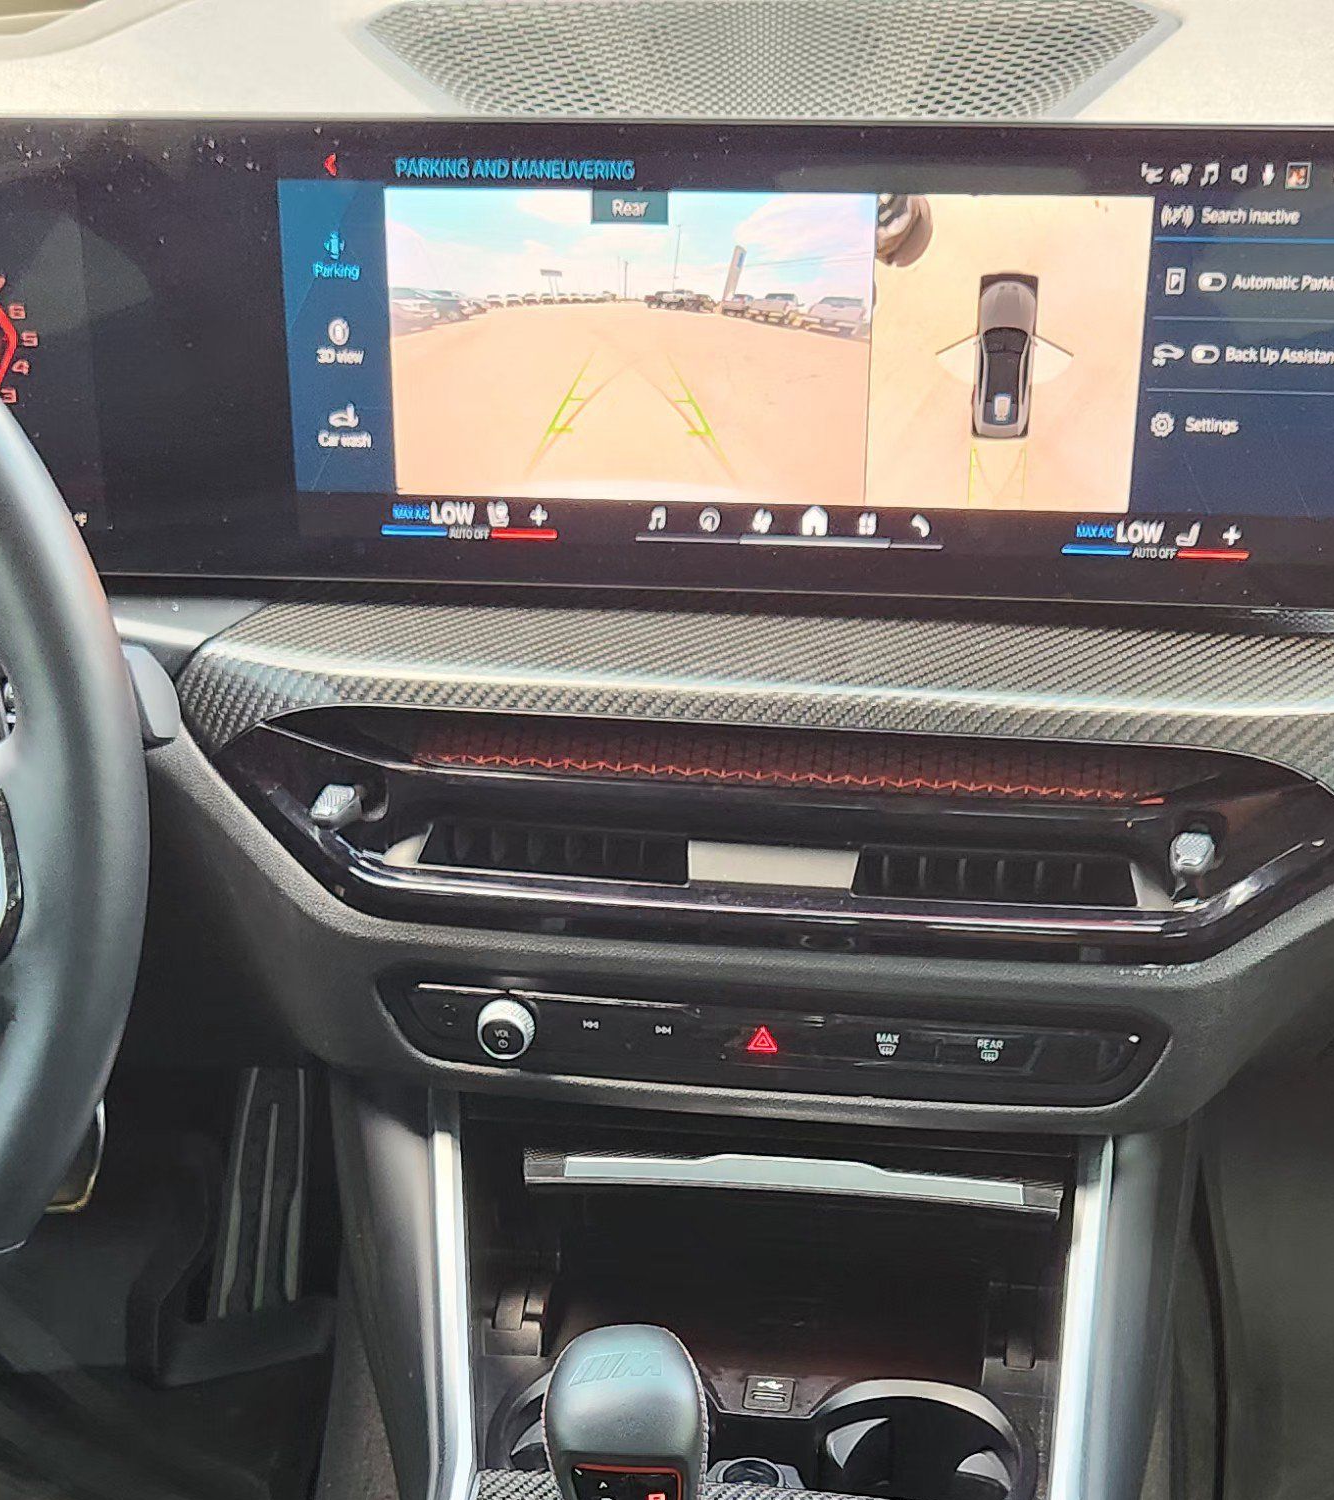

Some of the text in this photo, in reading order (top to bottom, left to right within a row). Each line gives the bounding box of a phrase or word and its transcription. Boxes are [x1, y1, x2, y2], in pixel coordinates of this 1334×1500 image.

[395, 157, 635, 181] PARKING AND MANEUVERING
[611, 198, 648, 217] Rear
[1201, 207, 1301, 226] Search inactive
[313, 262, 360, 281] Parking
[1231, 274, 1299, 291] Automatic
[317, 348, 364, 365] 3D view
[1225, 347, 1259, 363] Back
[1260, 348, 1279, 366] Up
[1185, 416, 1239, 435] Settings
[318, 430, 372, 448] Car wash
[430, 501, 476, 526] LOW
[447, 525, 490, 540] AUTO OFF
[1076, 523, 1098, 538] MAX
[1116, 520, 1165, 544] LOW
[1132, 546, 1178, 560] AUTO OFF
[494, 1029, 510, 1040] VOL
[875, 1032, 900, 1044] MAX
[977, 1038, 1004, 1051] REAR
